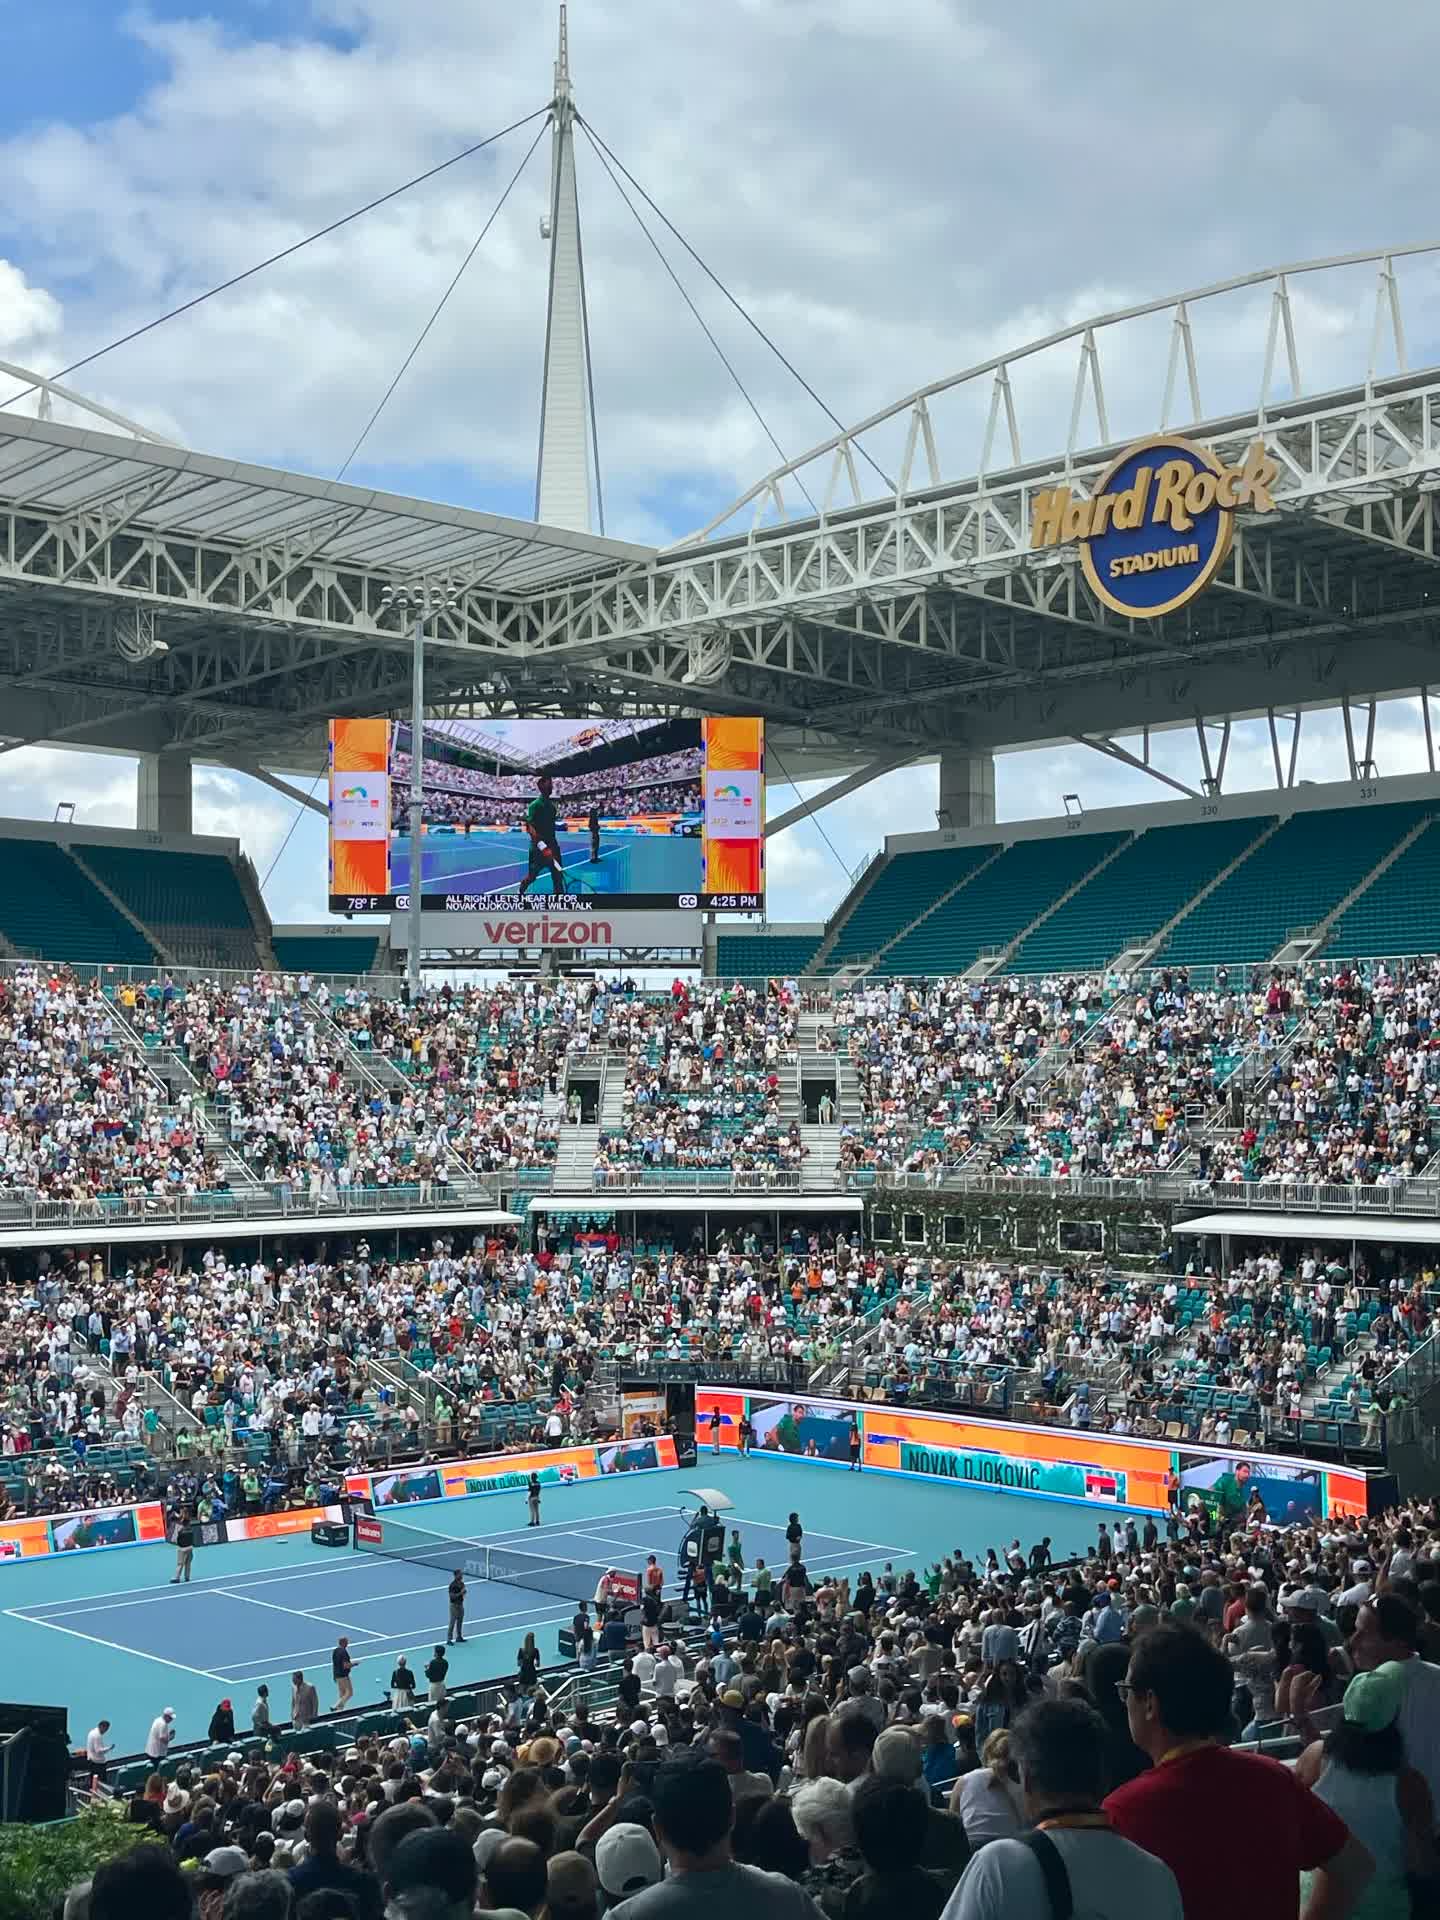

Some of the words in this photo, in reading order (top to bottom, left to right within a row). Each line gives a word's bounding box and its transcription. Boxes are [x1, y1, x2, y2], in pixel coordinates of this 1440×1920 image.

[1031, 466, 1152, 548] Hard
[1152, 441, 1279, 531] Rock
[1110, 544, 1199, 578] STADIUM
[1360, 788, 1377, 798] 331
[370, 898, 378, 909] F
[446, 895, 460, 903] ALL
[521, 895, 546, 903] HEAR
[547, 895, 556, 903] IT
[558, 895, 577, 903] FOR
[681, 897, 696, 906] CC
[710, 897, 736, 907] 4:25
[740, 897, 757, 907] PM
[446, 903, 477, 911] NOVAK
[531, 903, 546, 911] WE
[547, 903, 569, 911] WILL
[570, 903, 593, 911] TALK
[484, 915, 612, 945] verizon
[909, 1450, 958, 1478] NOVAK
[963, 1458, 1040, 1490] DJOKOVIC
[469, 1479, 497, 1493] NOVAK
